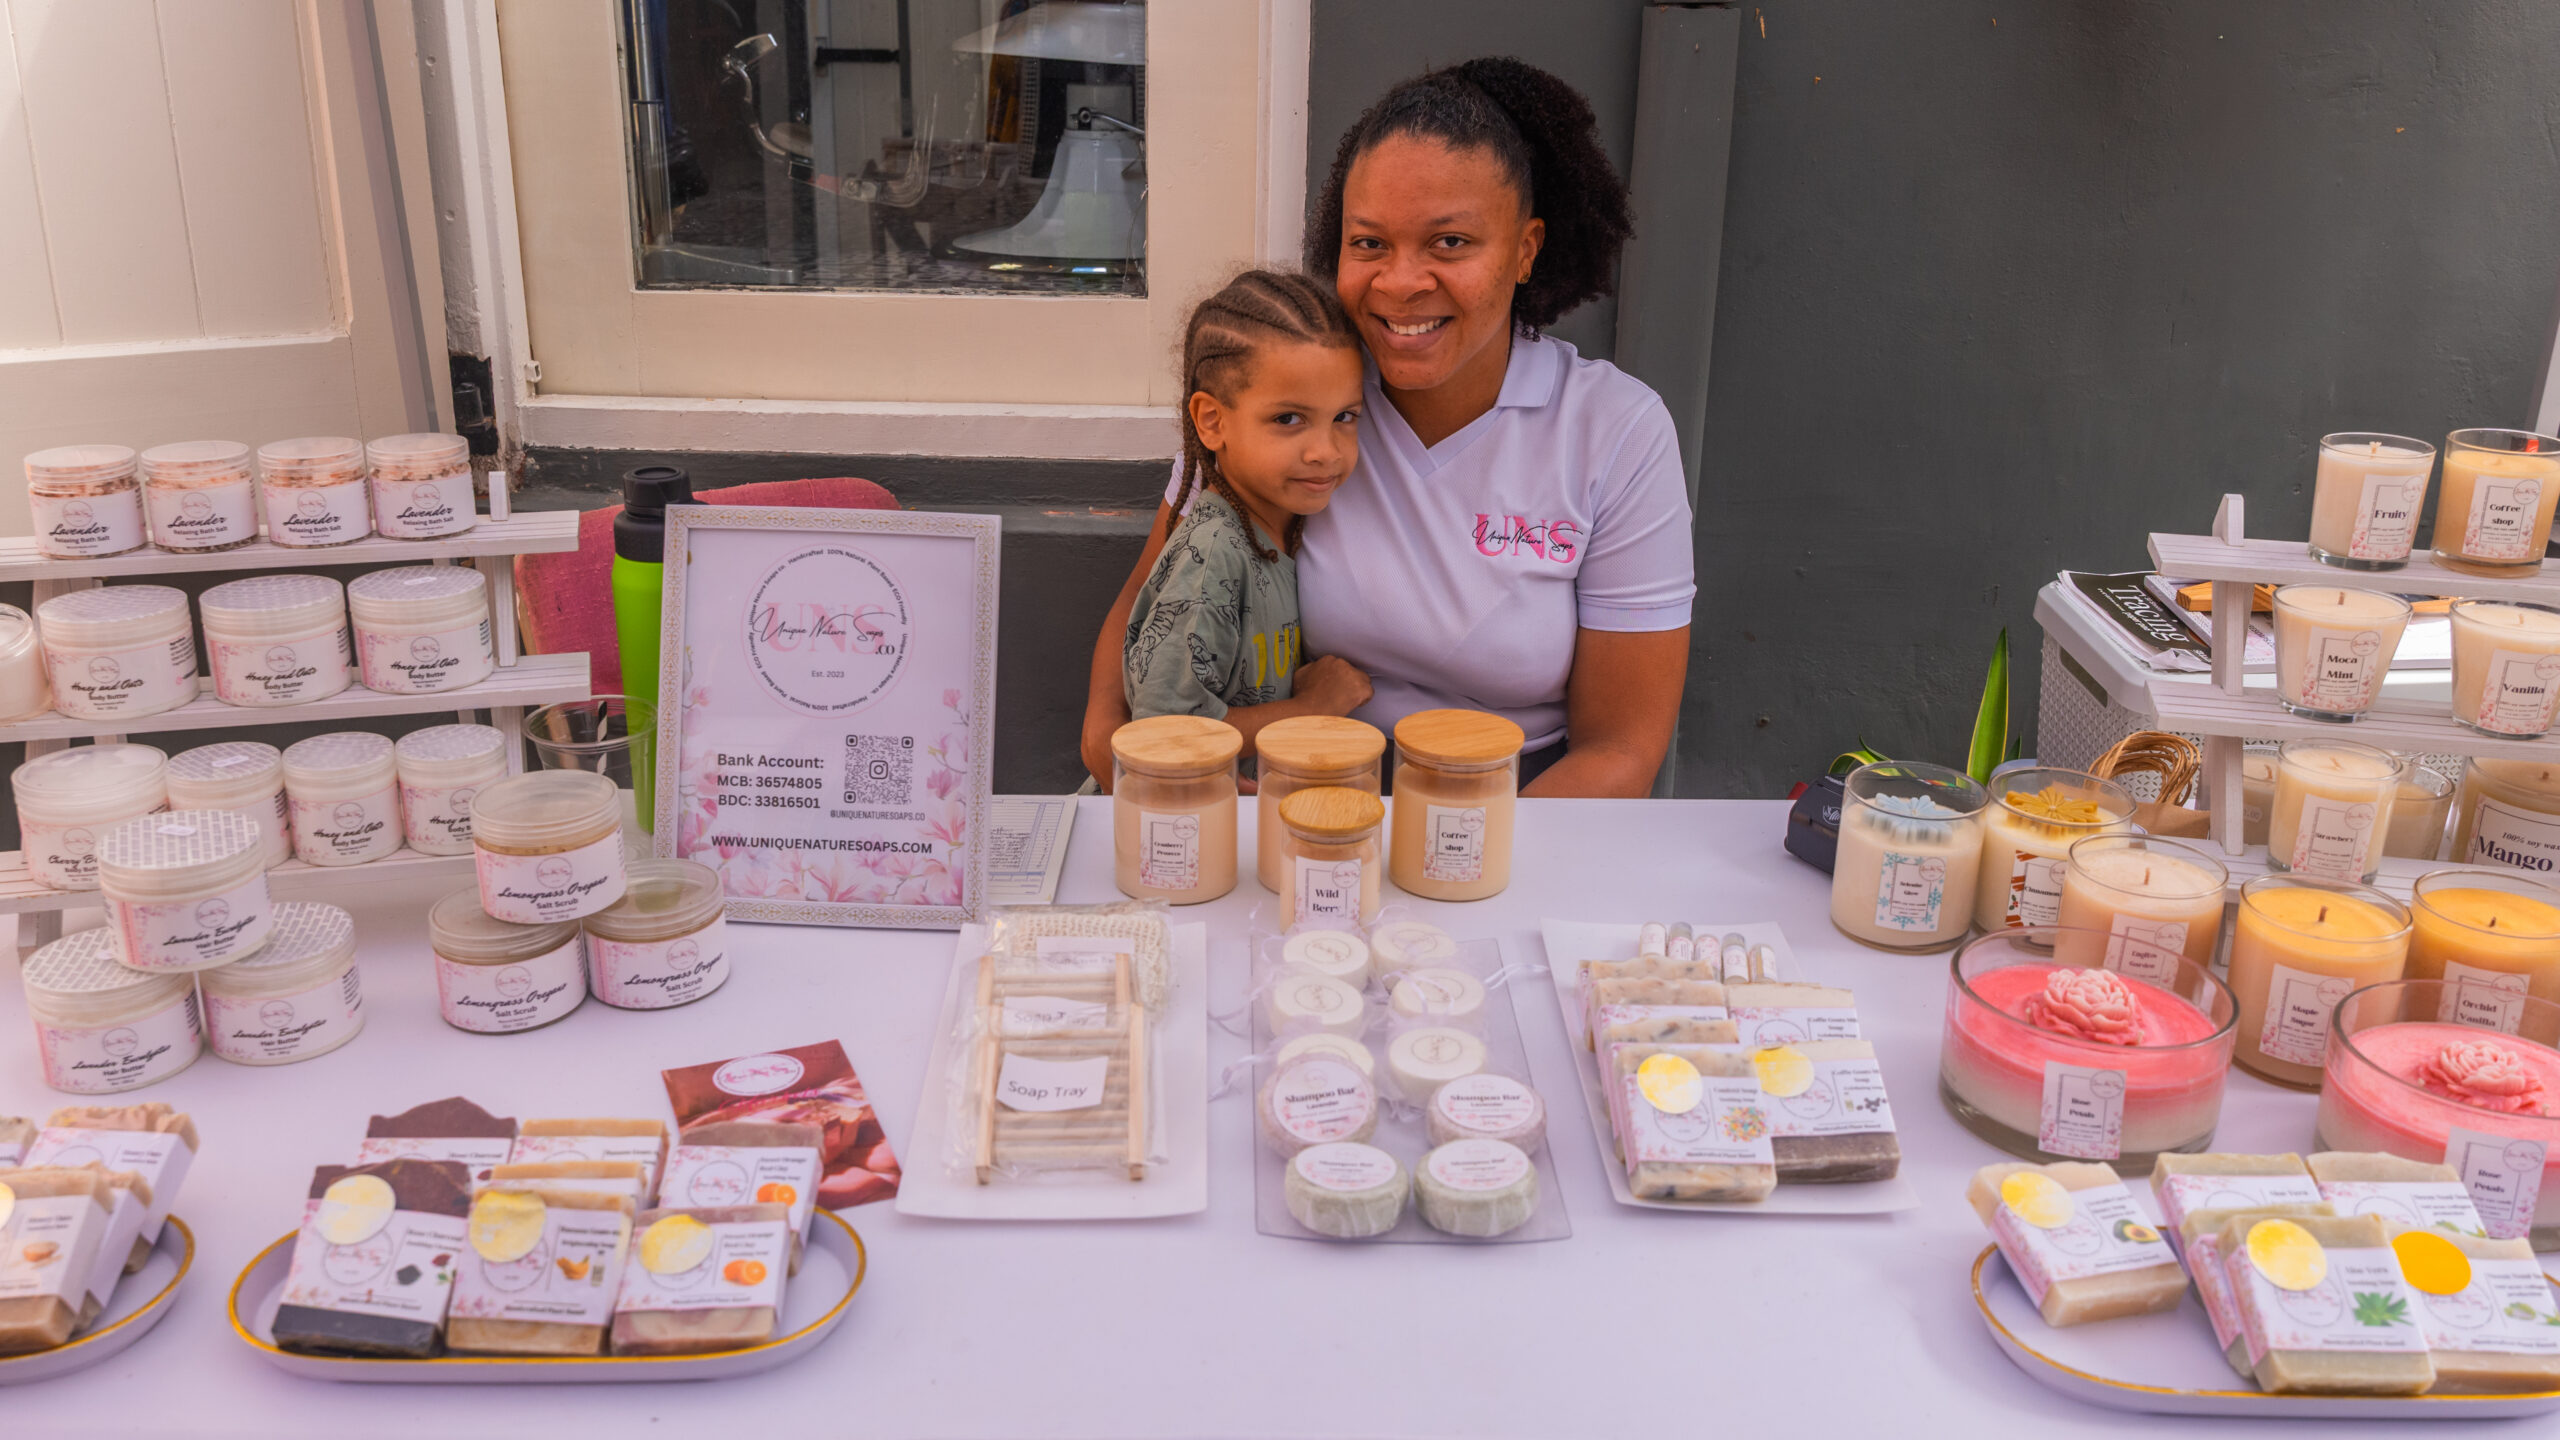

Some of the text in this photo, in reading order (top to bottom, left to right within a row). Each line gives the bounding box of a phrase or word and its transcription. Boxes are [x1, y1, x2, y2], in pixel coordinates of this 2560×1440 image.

[397, 504, 453, 519] Lavender
[2490, 504, 2520, 512] Coffee
[168, 514, 228, 528] Lavender
[283, 513, 341, 526] Lavender
[2374, 510, 2408, 521] Fruity
[2492, 518, 2514, 526] shop
[49, 522, 110, 536] Lavender
[314, 526, 329, 534] Bath
[1475, 513, 1577, 564] UNS
[2106, 585, 2190, 642] Tracing
[752, 608, 896, 642] Unique Nature Soaps
[765, 602, 886, 655] UNS
[390, 662, 418, 672] Honey
[420, 660, 439, 669] and
[2327, 654, 2358, 664] Moca
[245, 672, 272, 682] Honey
[274, 669, 296, 680] and
[811, 670, 825, 678] Est.
[2327, 670, 2353, 679] Mint
[71, 682, 96, 693] Honey
[99, 680, 119, 690] and
[2502, 683, 2545, 694] Vanilla
[718, 754, 824, 768] Bank Account:
[717, 775, 822, 789] MCB: 36574805
[718, 795, 821, 808] BDC: 33816501
[430, 816, 457, 826] Honey
[314, 830, 340, 840] Honey
[344, 826, 364, 836] and
[2502, 832, 2524, 844] 100%
[2527, 840, 2540, 848] soy
[712, 836, 932, 854] WWW.UNIQUENATURESOAPS.COM
[1445, 844, 1464, 852] shop
[2474, 836, 2552, 872] Mango
[48, 855, 80, 870] Cherry
[498, 886, 564, 904] Lemongrass
[1316, 889, 1338, 898] Wild
[554, 898, 579, 907] Scrub
[624, 971, 692, 988] Lemongrass
[666, 984, 682, 992] Salt
[456, 994, 523, 1012] Lemongrass
[2462, 999, 2498, 1014] Orchid
[496, 1006, 538, 1018] Salt Scrub
[1008, 1080, 1088, 1100] Soap Tray
[1285, 1086, 1356, 1104] Shampoo Bar
